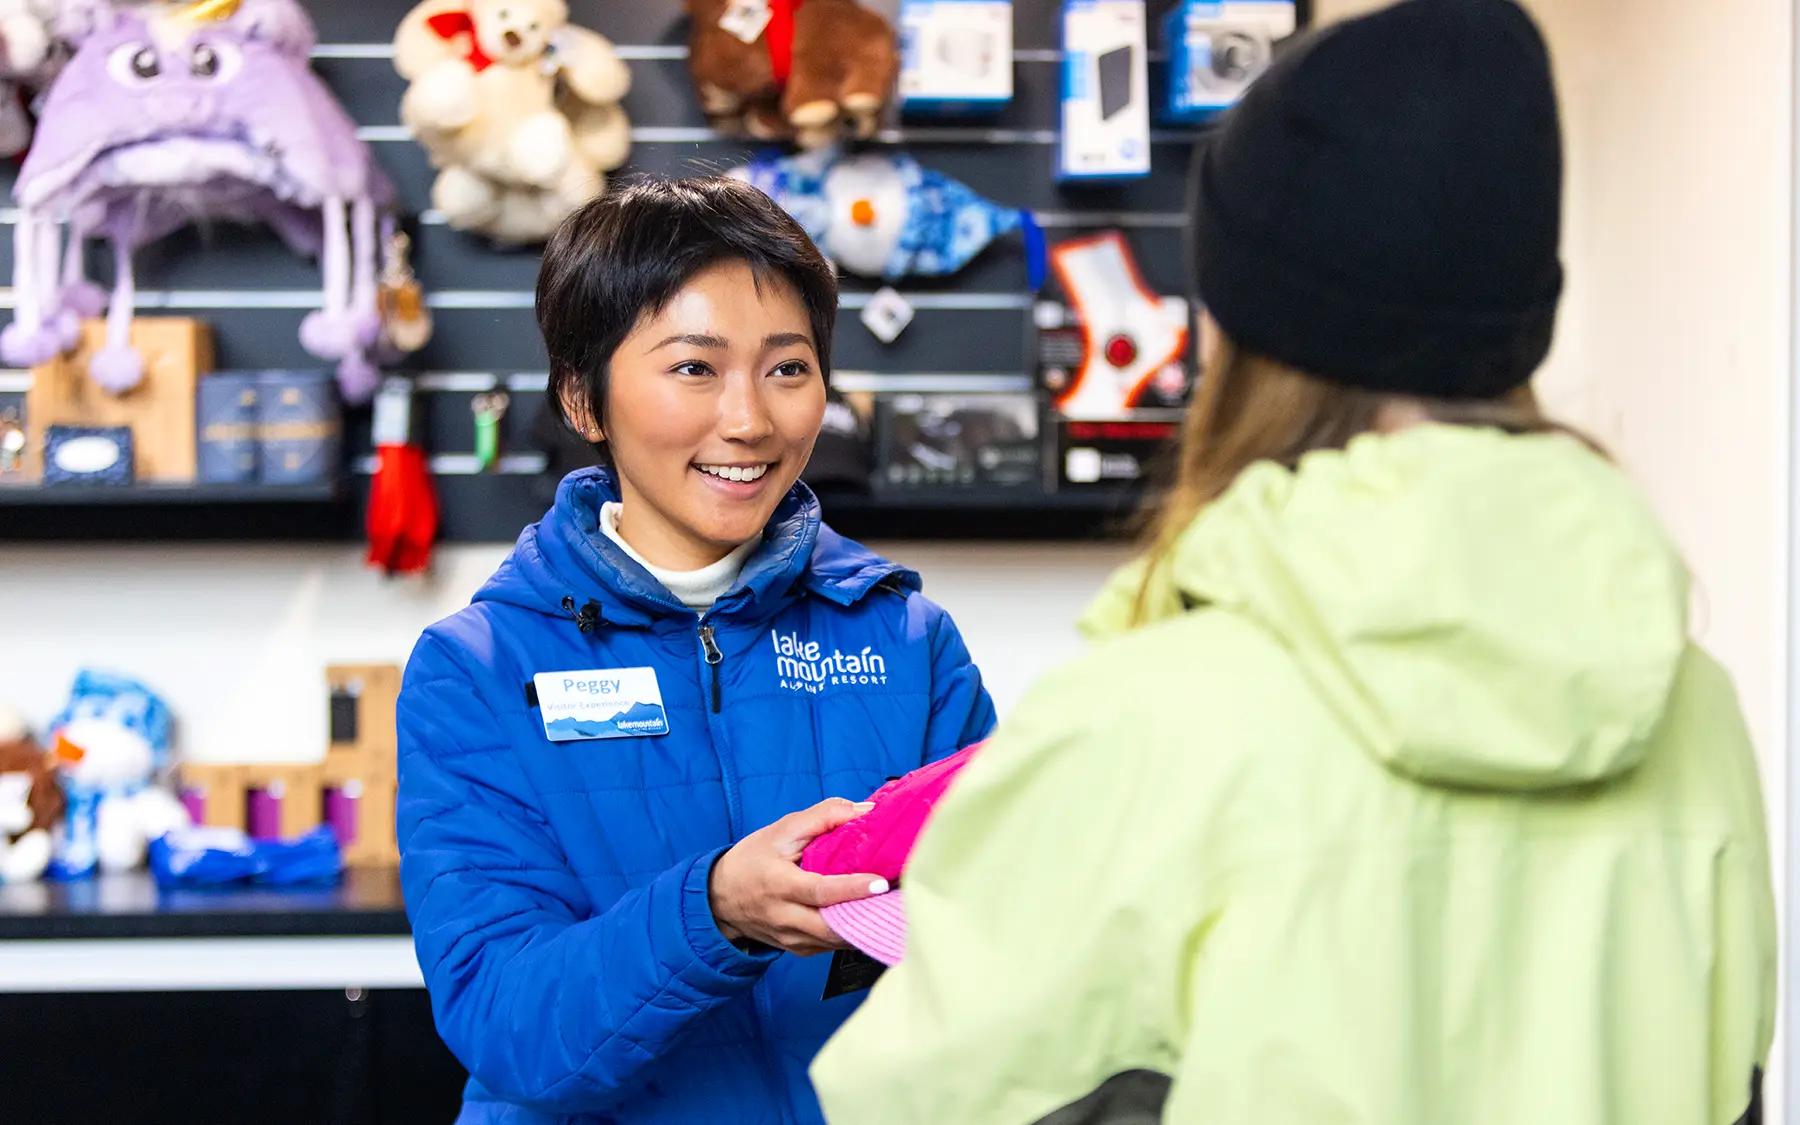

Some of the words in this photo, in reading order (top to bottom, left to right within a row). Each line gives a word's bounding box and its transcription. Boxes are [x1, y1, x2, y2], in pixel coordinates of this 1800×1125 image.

[771, 629, 820, 661] lake
[777, 646, 885, 682] mountain
[563, 679, 620, 694] Peggy
[832, 675, 887, 685] RESORT
[546, 701, 576, 710] Visitor
[580, 699, 630, 709] Experience
